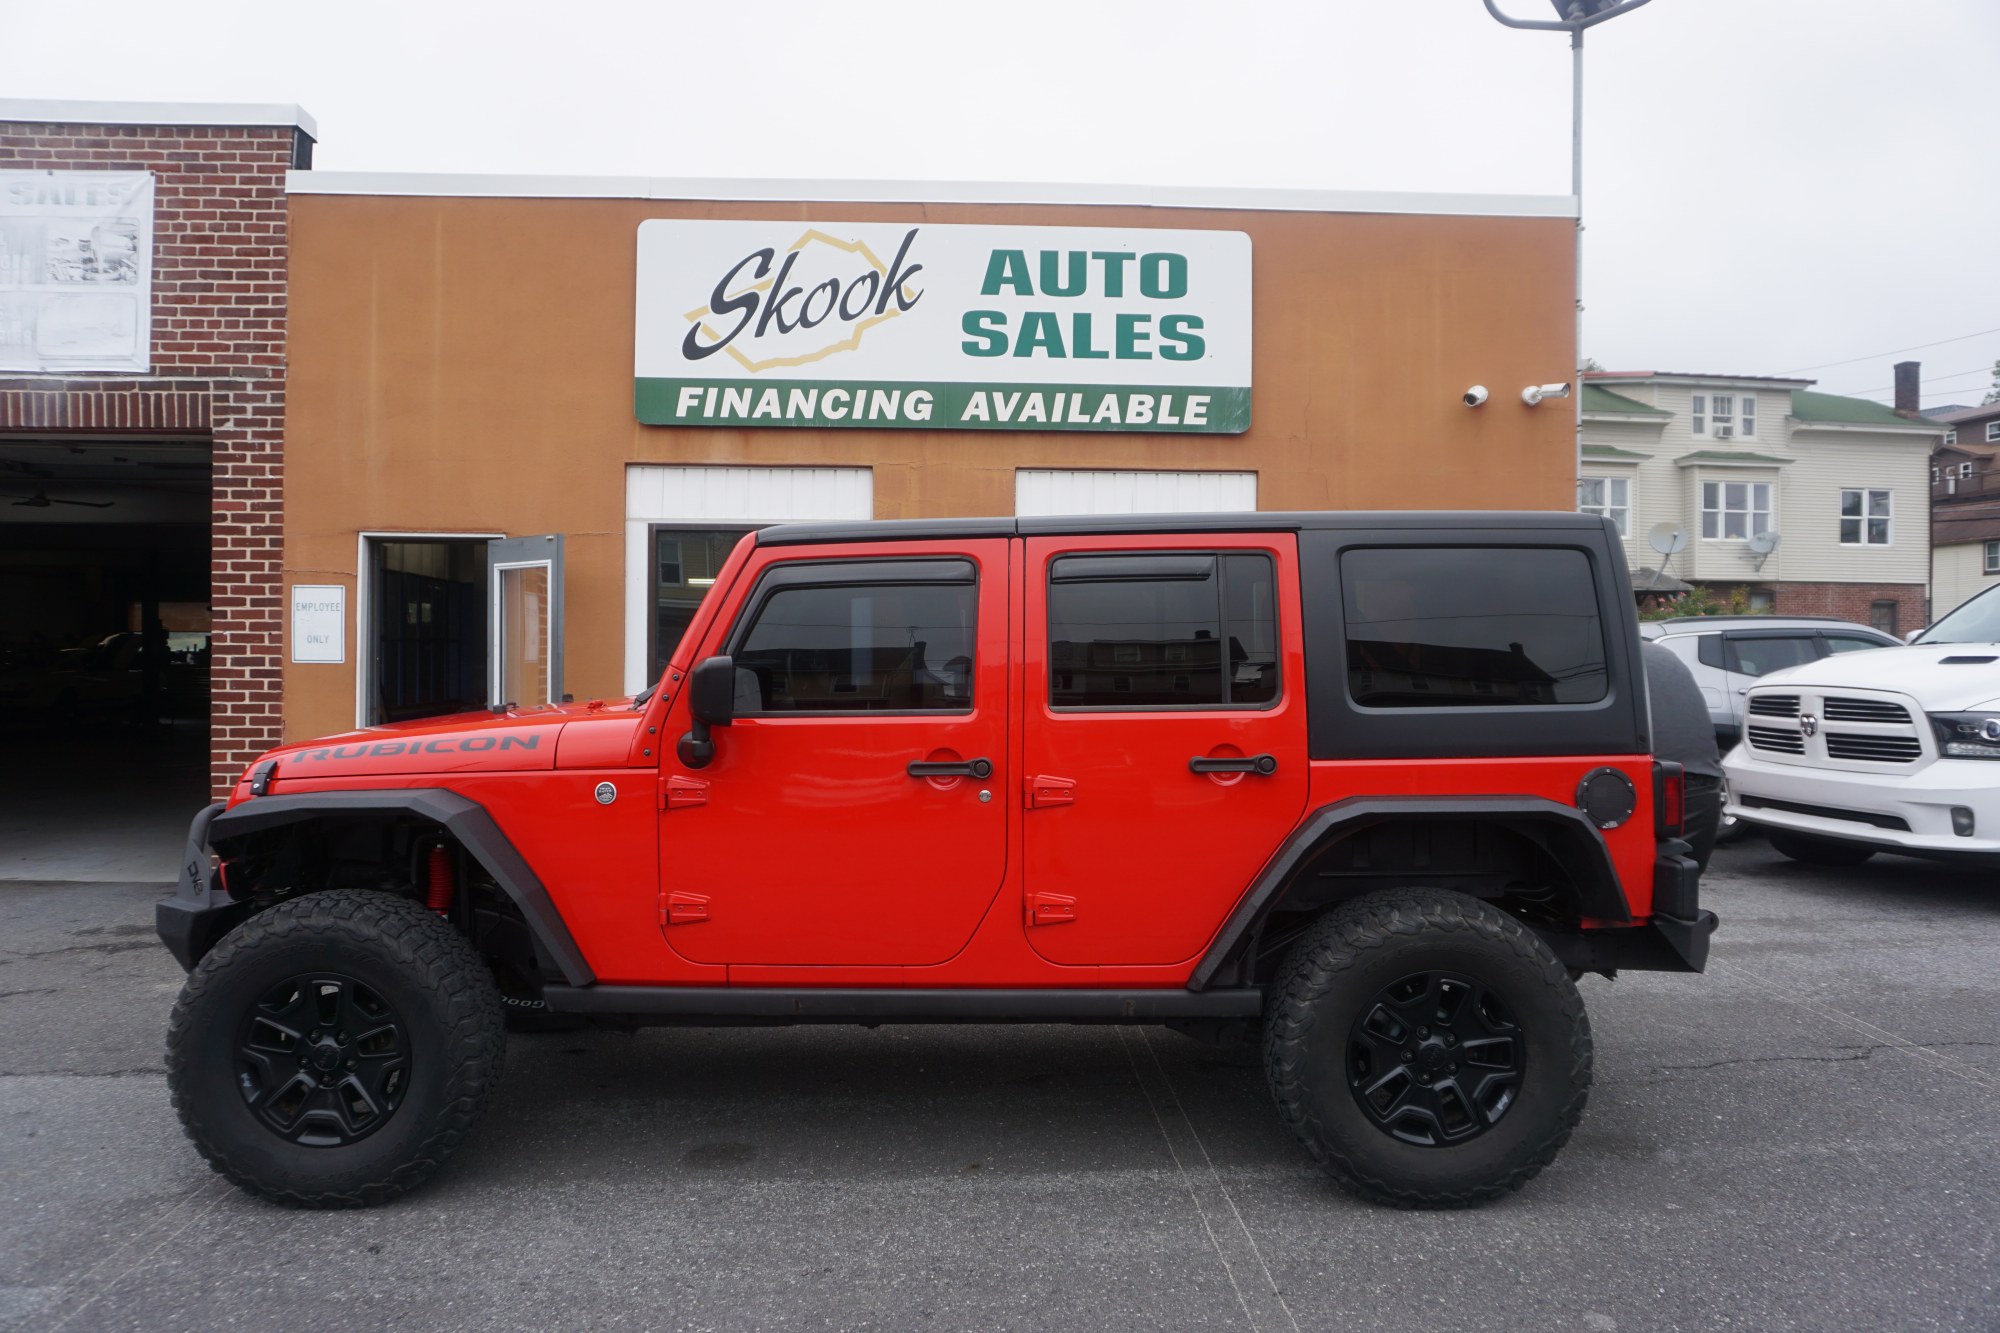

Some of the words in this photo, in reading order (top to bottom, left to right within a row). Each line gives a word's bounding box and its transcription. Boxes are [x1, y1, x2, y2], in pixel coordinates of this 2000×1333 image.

[682, 228, 925, 361] Skook
[979, 249, 1189, 300] AUTO
[961, 310, 1206, 361] SALES
[675, 386, 934, 422] FINANCING
[960, 391, 1211, 426] AVAILABLE
[295, 602, 341, 612] EMPLOYEE
[306, 634, 330, 644] ONLY
[293, 735, 541, 763] RUBICON
